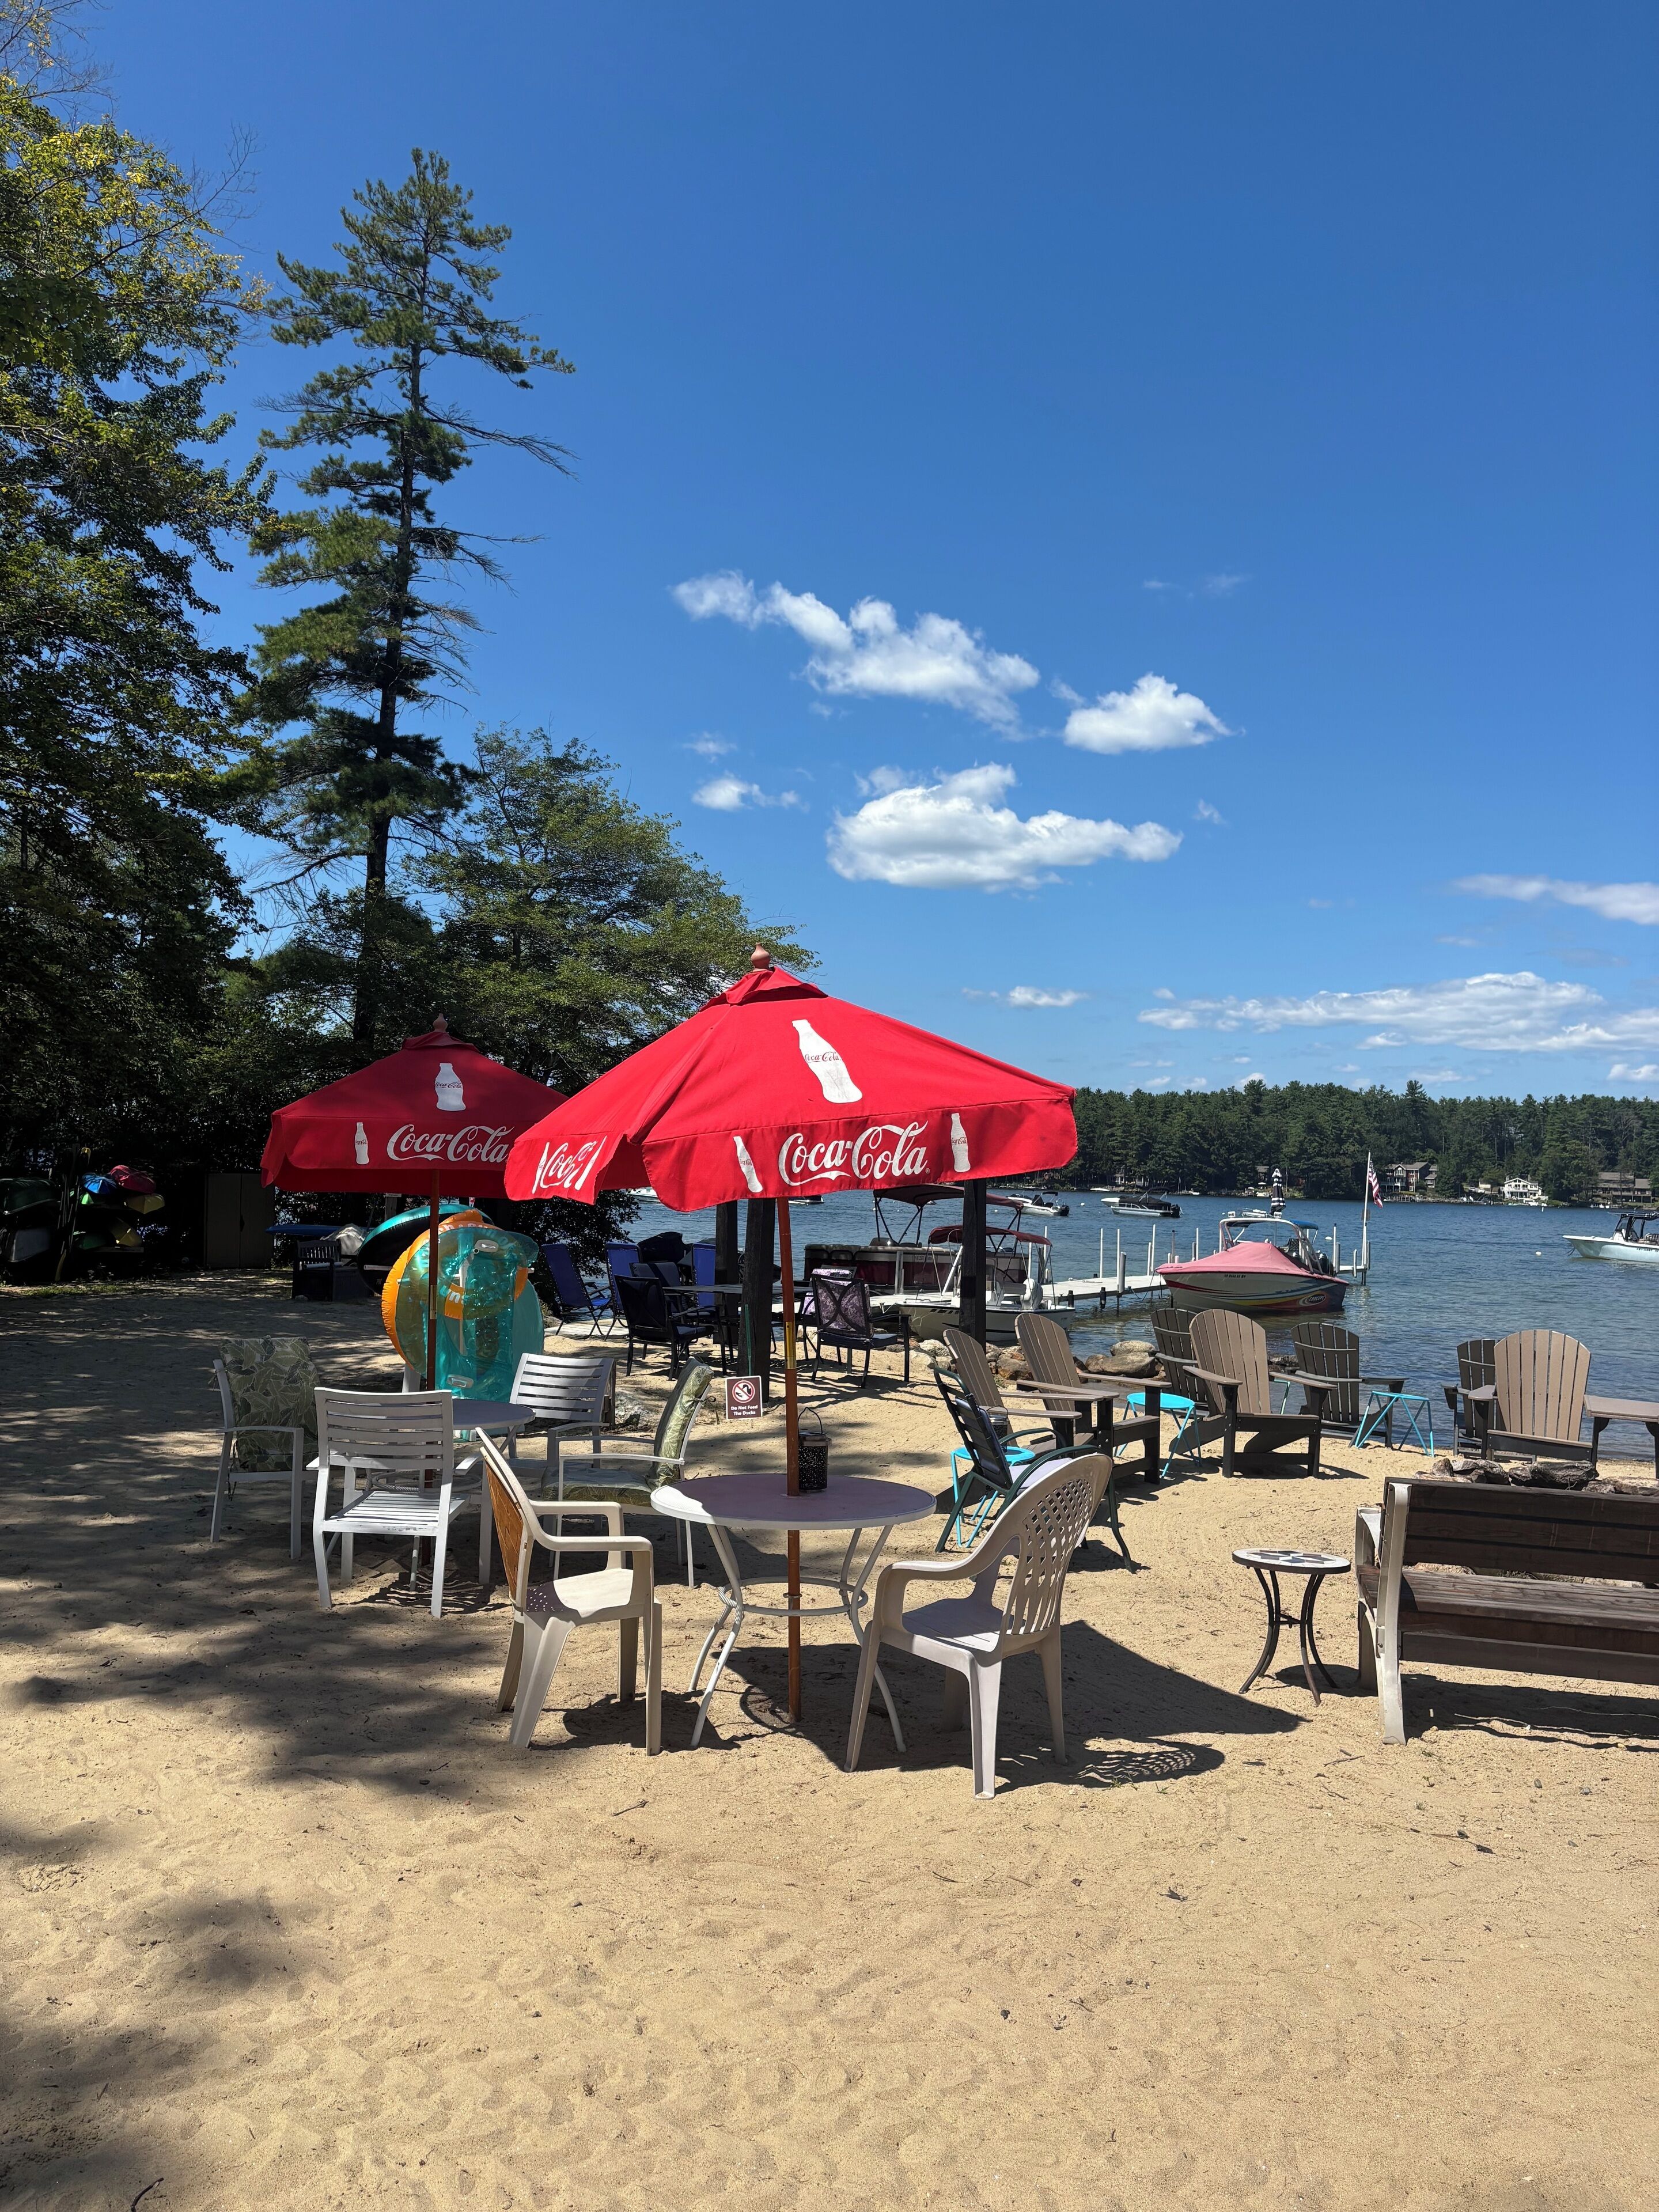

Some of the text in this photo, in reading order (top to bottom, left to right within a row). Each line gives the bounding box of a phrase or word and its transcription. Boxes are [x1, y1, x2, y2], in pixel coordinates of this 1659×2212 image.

[805, 1051, 839, 1063] Coca-Cola
[387, 1124, 515, 1162] Coca-Cola
[778, 1120, 929, 1186] Coca-Cola
